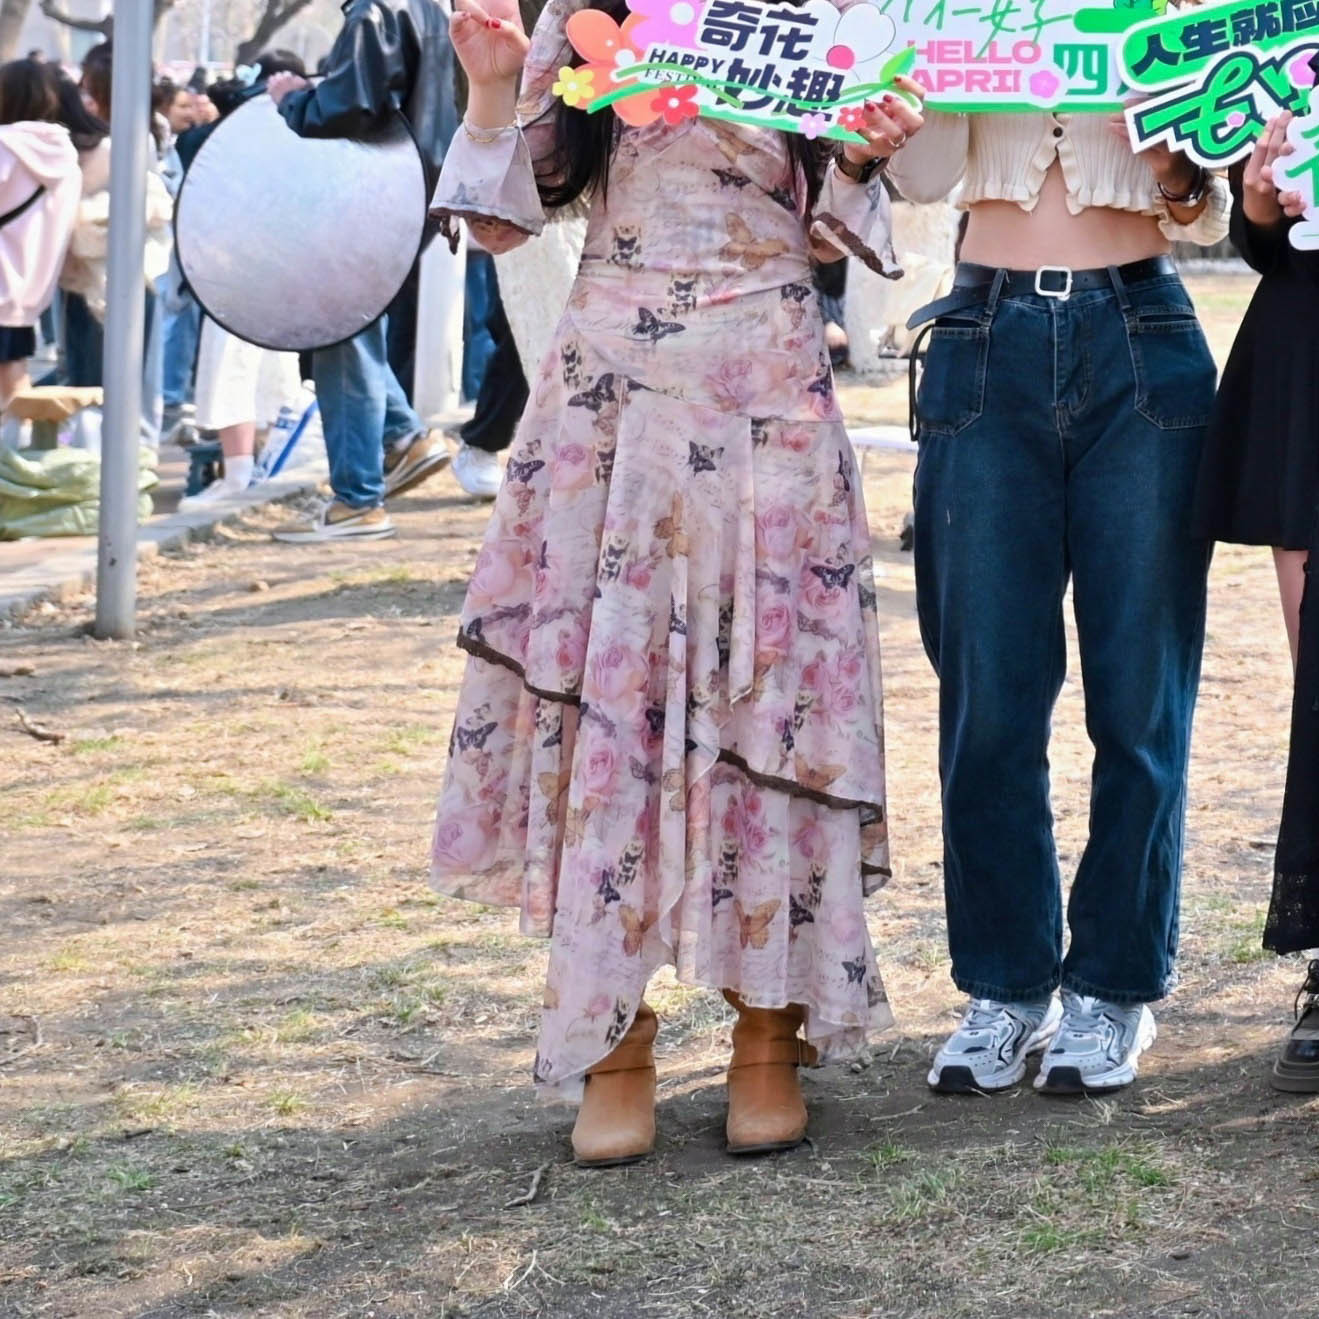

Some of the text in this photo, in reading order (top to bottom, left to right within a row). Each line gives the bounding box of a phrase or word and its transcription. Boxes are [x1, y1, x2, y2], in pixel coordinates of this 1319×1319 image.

[701, 0, 819, 61] 奇花
[907, 40, 1042, 64] HELLO
[648, 48, 725, 74] HAPPY
[1053, 44, 1128, 96] 四
[715, 58, 845, 122] 妙趣
